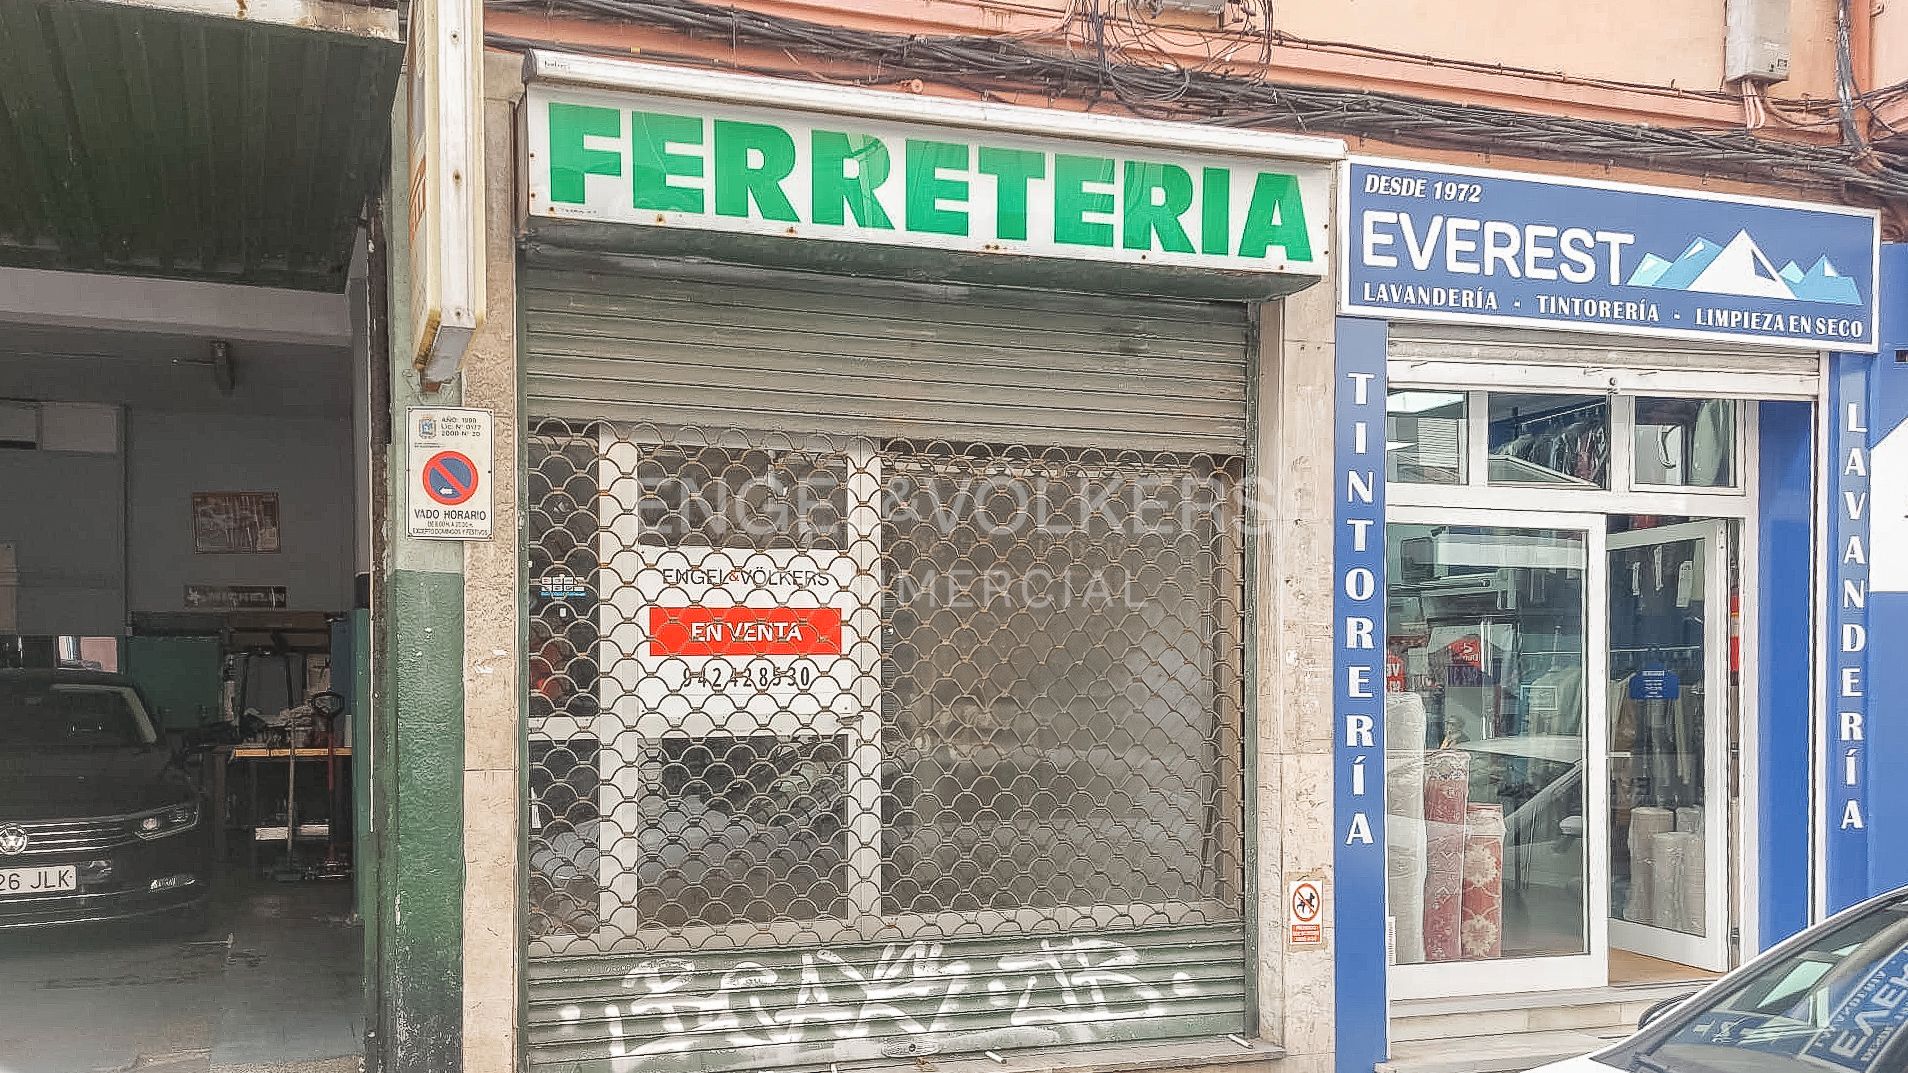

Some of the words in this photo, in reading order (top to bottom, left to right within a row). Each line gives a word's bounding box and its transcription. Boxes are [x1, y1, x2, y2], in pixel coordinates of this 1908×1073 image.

[548, 102, 1315, 263] FERRETERIA
[1364, 174, 1427, 198] DESDE
[1433, 181, 1483, 203] 1972
[1362, 209, 1636, 286] EVEREST
[1363, 281, 1498, 311] LAVANDERÍA
[1536, 294, 1660, 322] TINTORERÍA
[1695, 307, 1785, 332] LIMPIEZA
[1789, 315, 1813, 334] EN
[1815, 318, 1864, 338] SECO
[414, 508, 440, 519] VADO
[443, 510, 487, 521] HORARIO
[690, 622, 723, 642] EN
[727, 621, 804, 642] VENTA
[1344, 372, 1375, 845] TINTORERÍA
[1838, 402, 1868, 830] LAVANDERÍA
[29, 869, 70, 890] JLK
